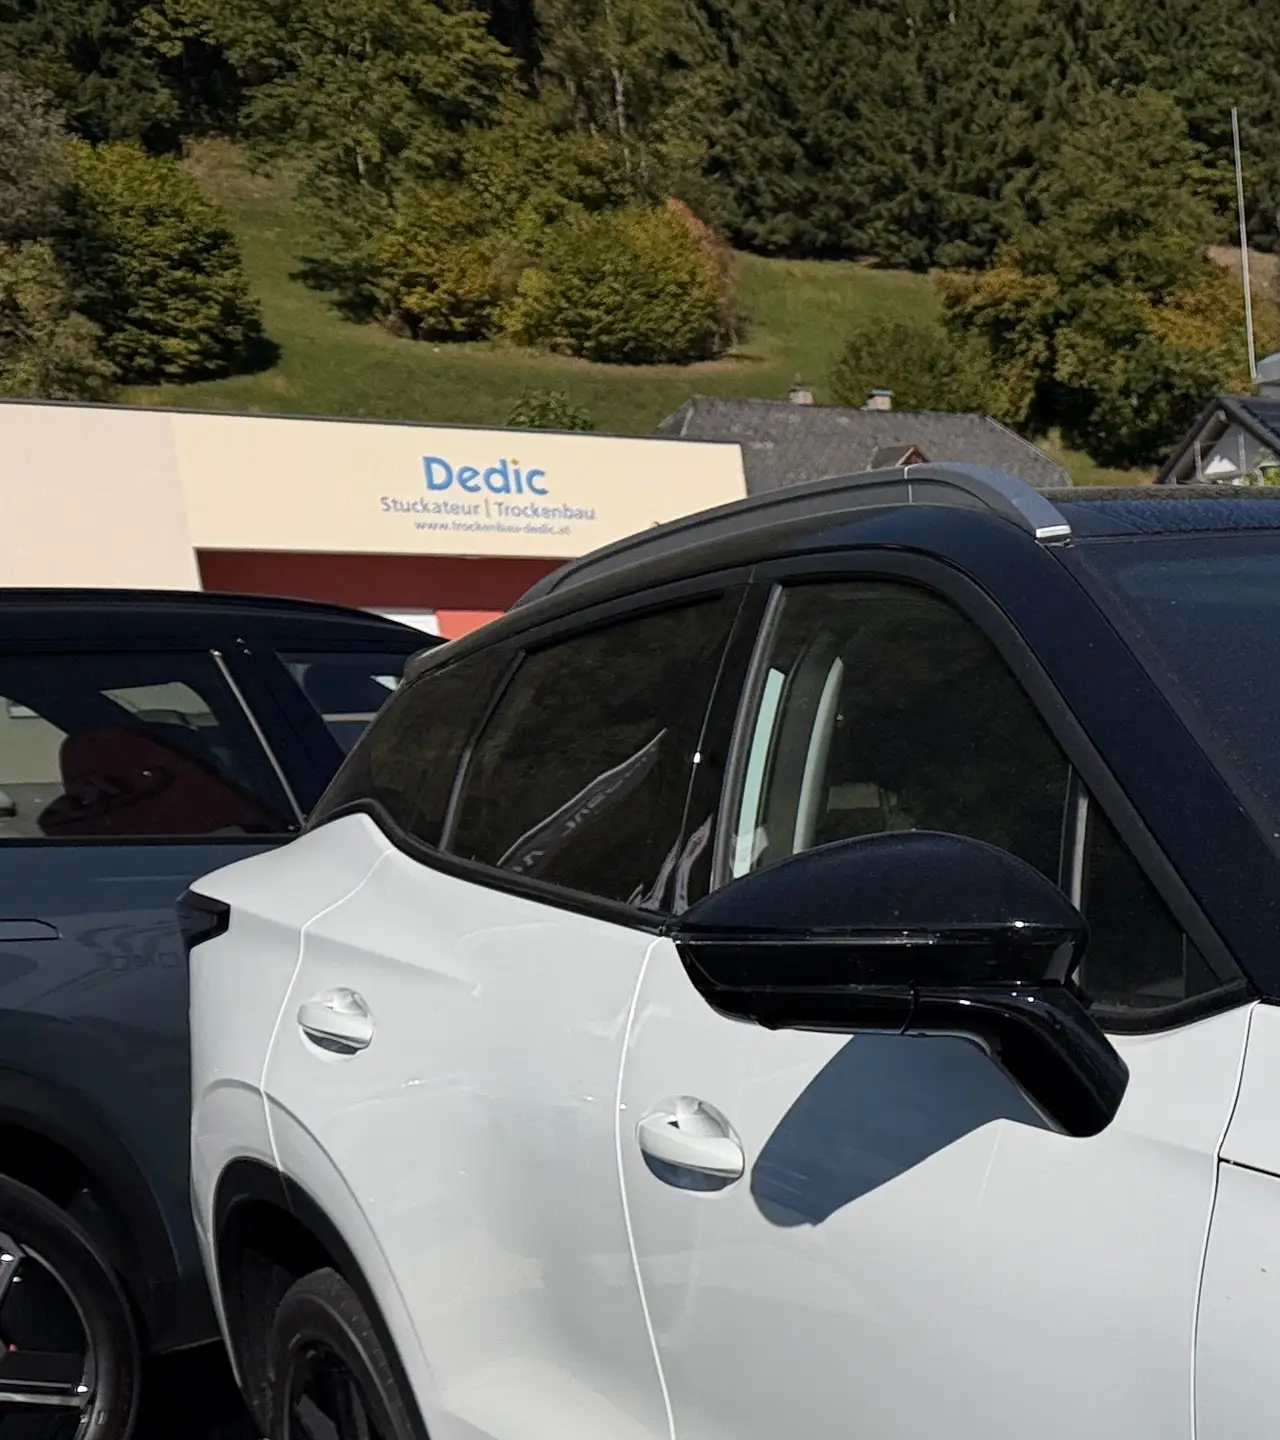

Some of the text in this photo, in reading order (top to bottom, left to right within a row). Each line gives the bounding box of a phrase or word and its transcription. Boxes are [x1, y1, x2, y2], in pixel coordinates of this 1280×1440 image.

[422, 456, 550, 496] Dedic
[380, 496, 596, 521] Stuckateur Trockenbau
